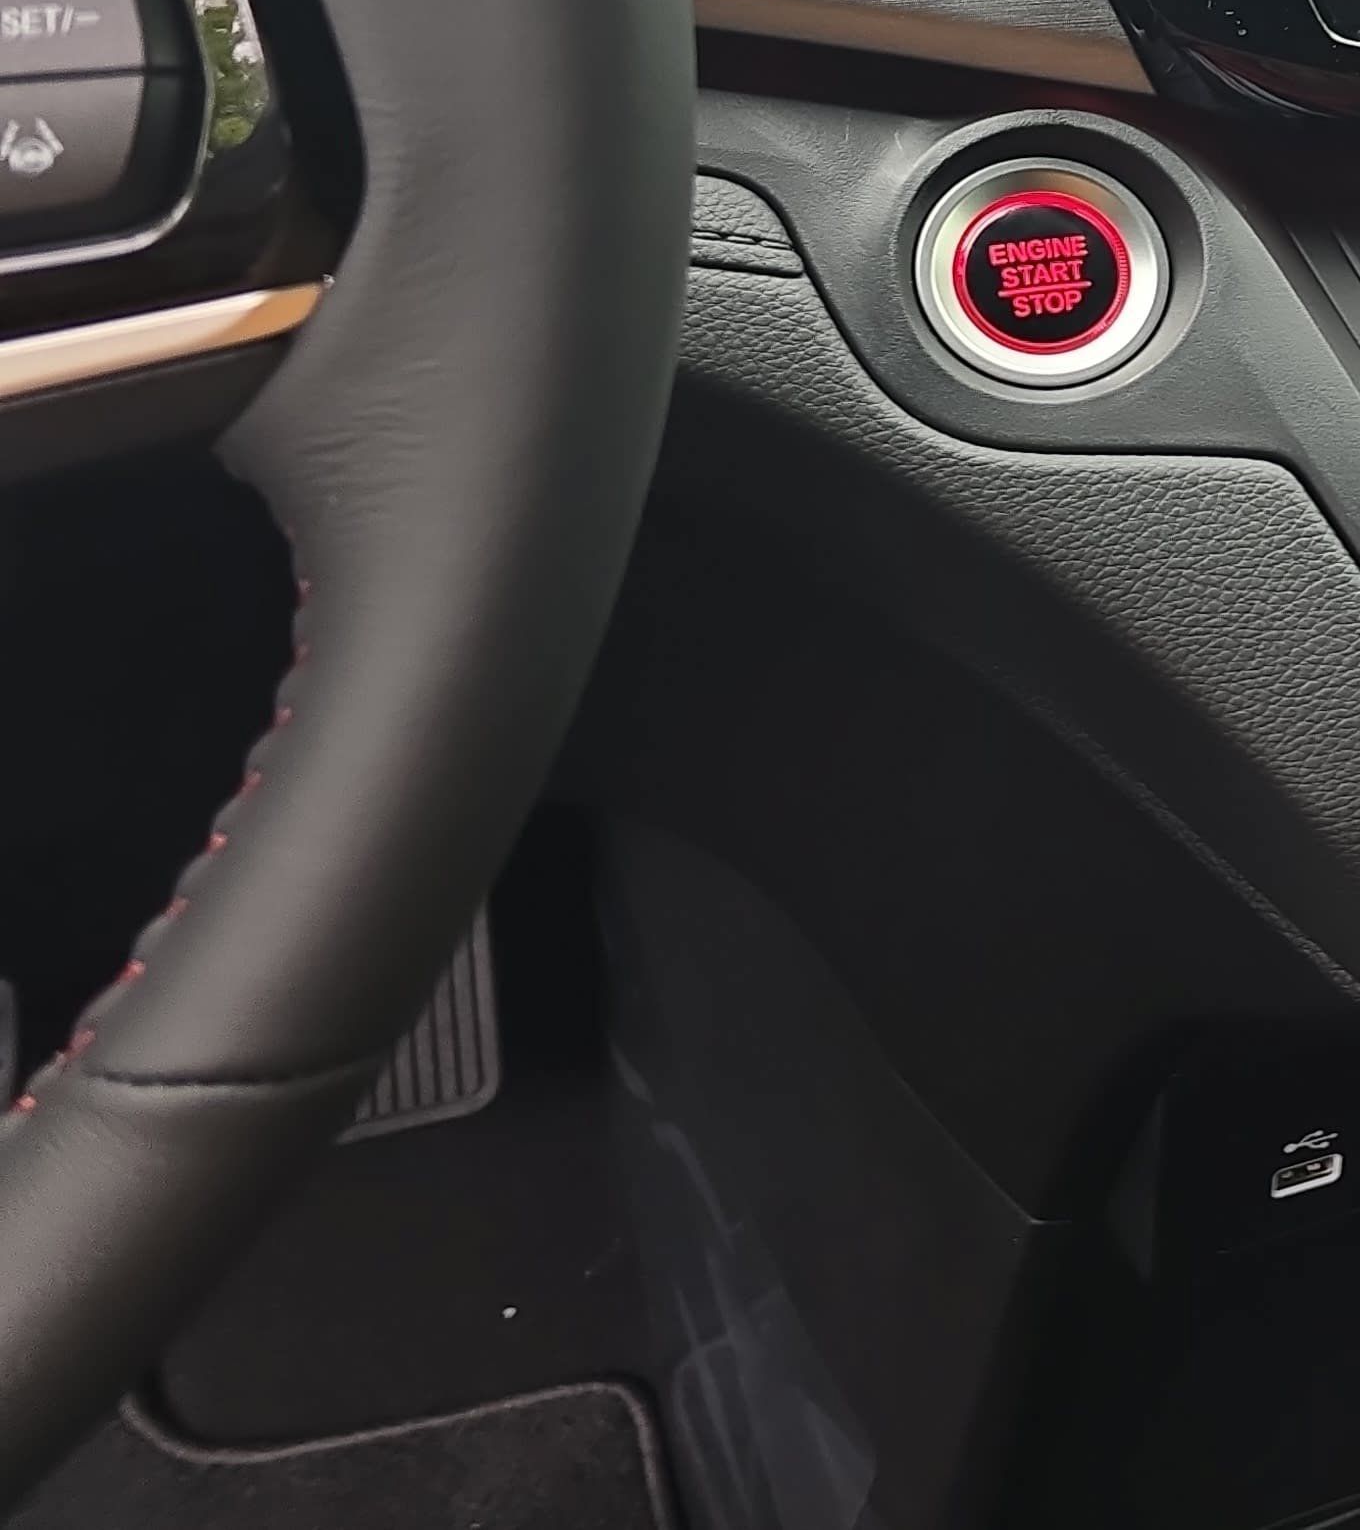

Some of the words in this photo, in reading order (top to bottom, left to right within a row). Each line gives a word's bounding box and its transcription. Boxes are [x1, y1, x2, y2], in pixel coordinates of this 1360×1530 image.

[988, 235, 1089, 266] ENGINE
[1001, 260, 1084, 287] START
[1012, 290, 1083, 318] STOP
